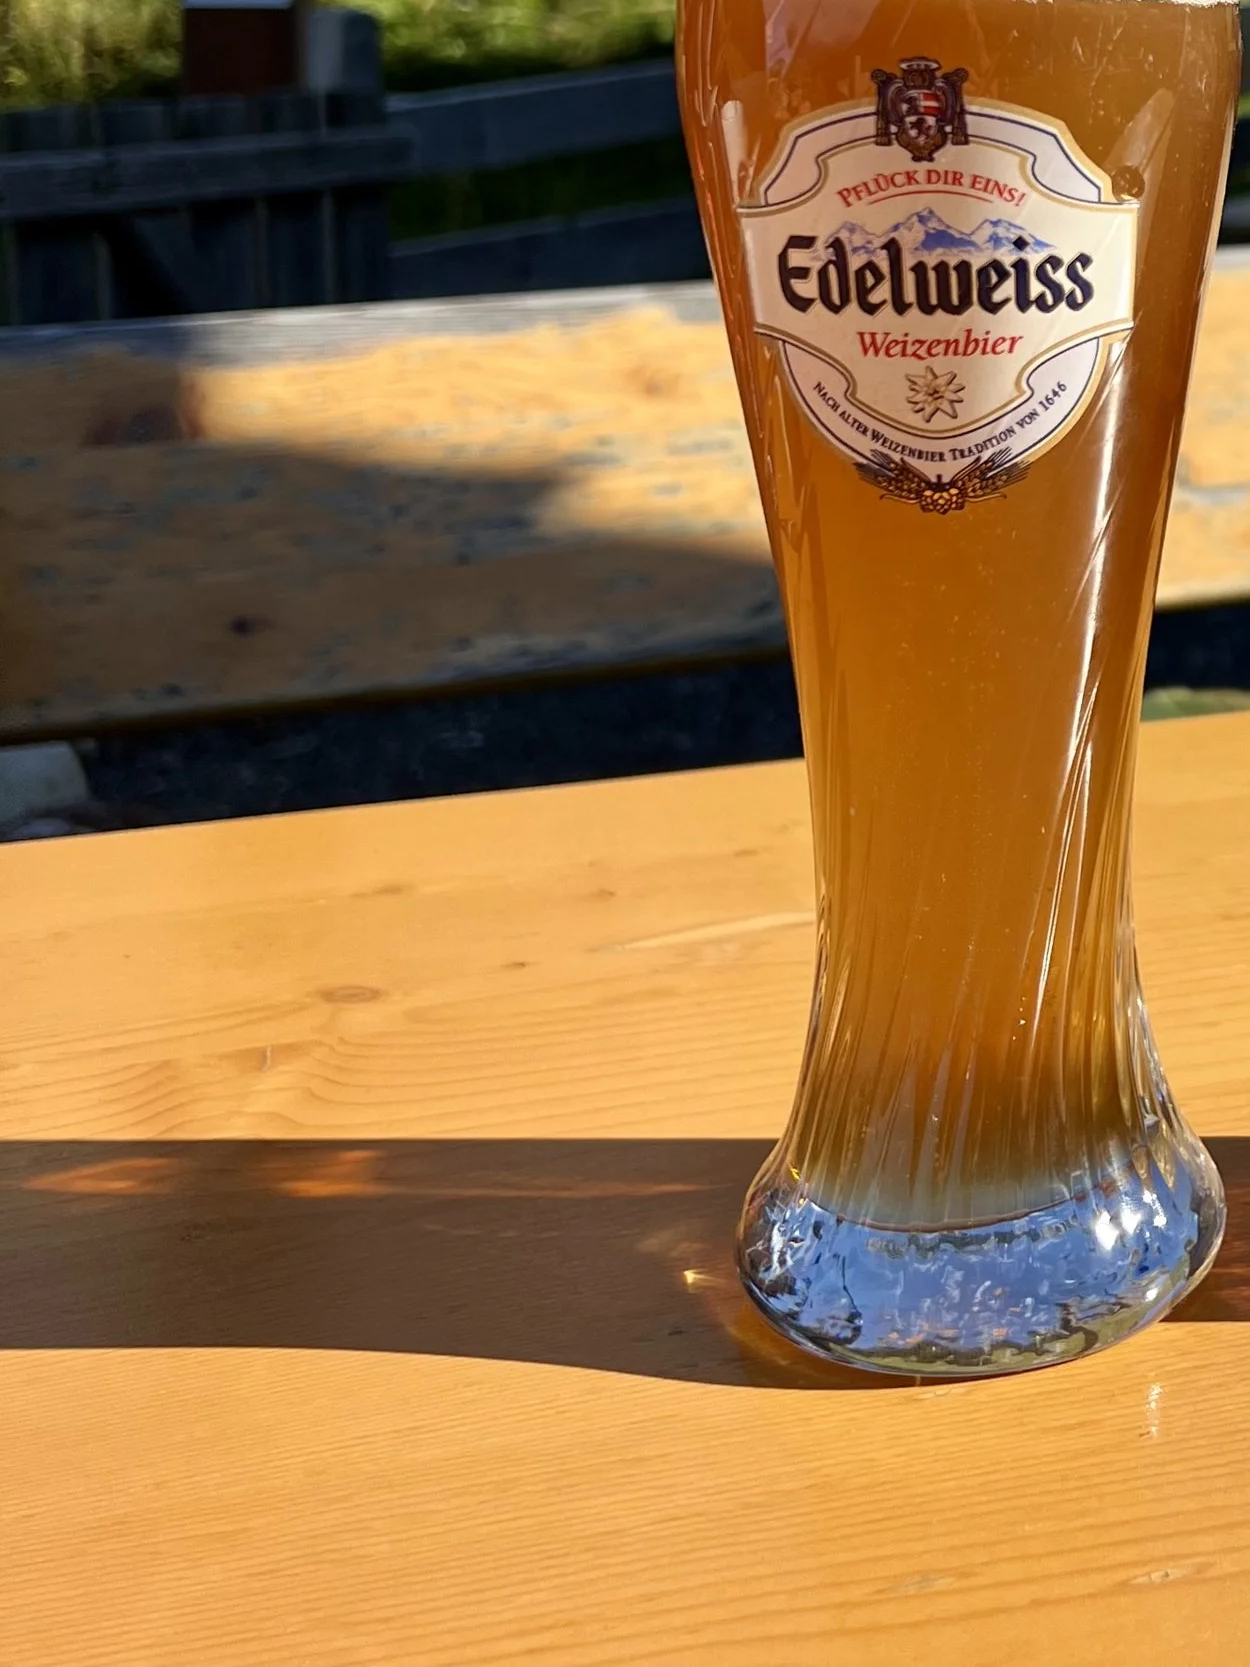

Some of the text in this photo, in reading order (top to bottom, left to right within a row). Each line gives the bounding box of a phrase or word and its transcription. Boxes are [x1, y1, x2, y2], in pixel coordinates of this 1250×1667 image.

[837, 169, 1026, 208] PFLÜCK DIR EINS!
[778, 235, 1094, 316] Edelweiss
[857, 329, 1023, 360] Weizenbier
[813, 381, 841, 413] NACH
[839, 410, 871, 436] ALTER
[949, 425, 1017, 461] TRADITION
[1016, 408, 1040, 430] VON
[1038, 381, 1067, 412] 1646
